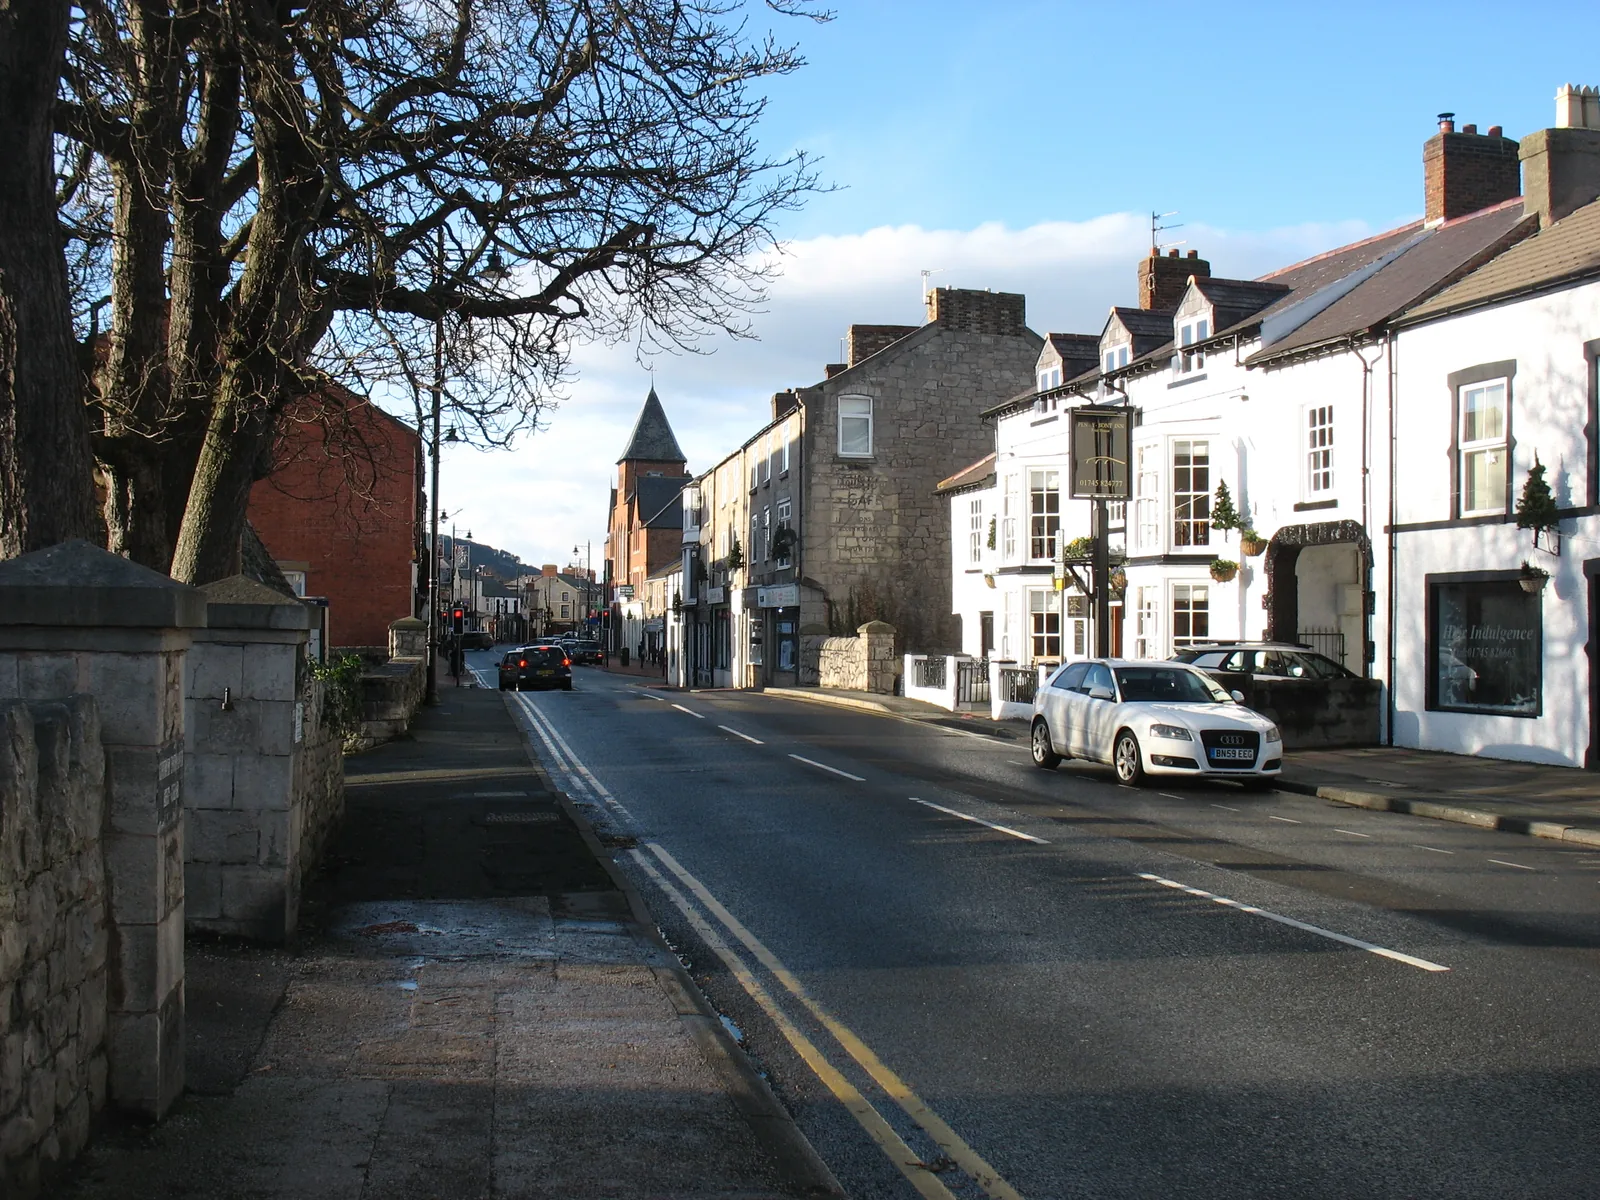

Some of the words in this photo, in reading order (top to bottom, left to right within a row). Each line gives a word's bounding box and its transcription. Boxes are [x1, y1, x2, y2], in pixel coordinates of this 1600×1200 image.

[1079, 479, 1099, 487] 01745
[1469, 624, 1534, 644] Indulgence
[1216, 749, 1237, 758] BN59
[1238, 750, 1253, 758] EEG
